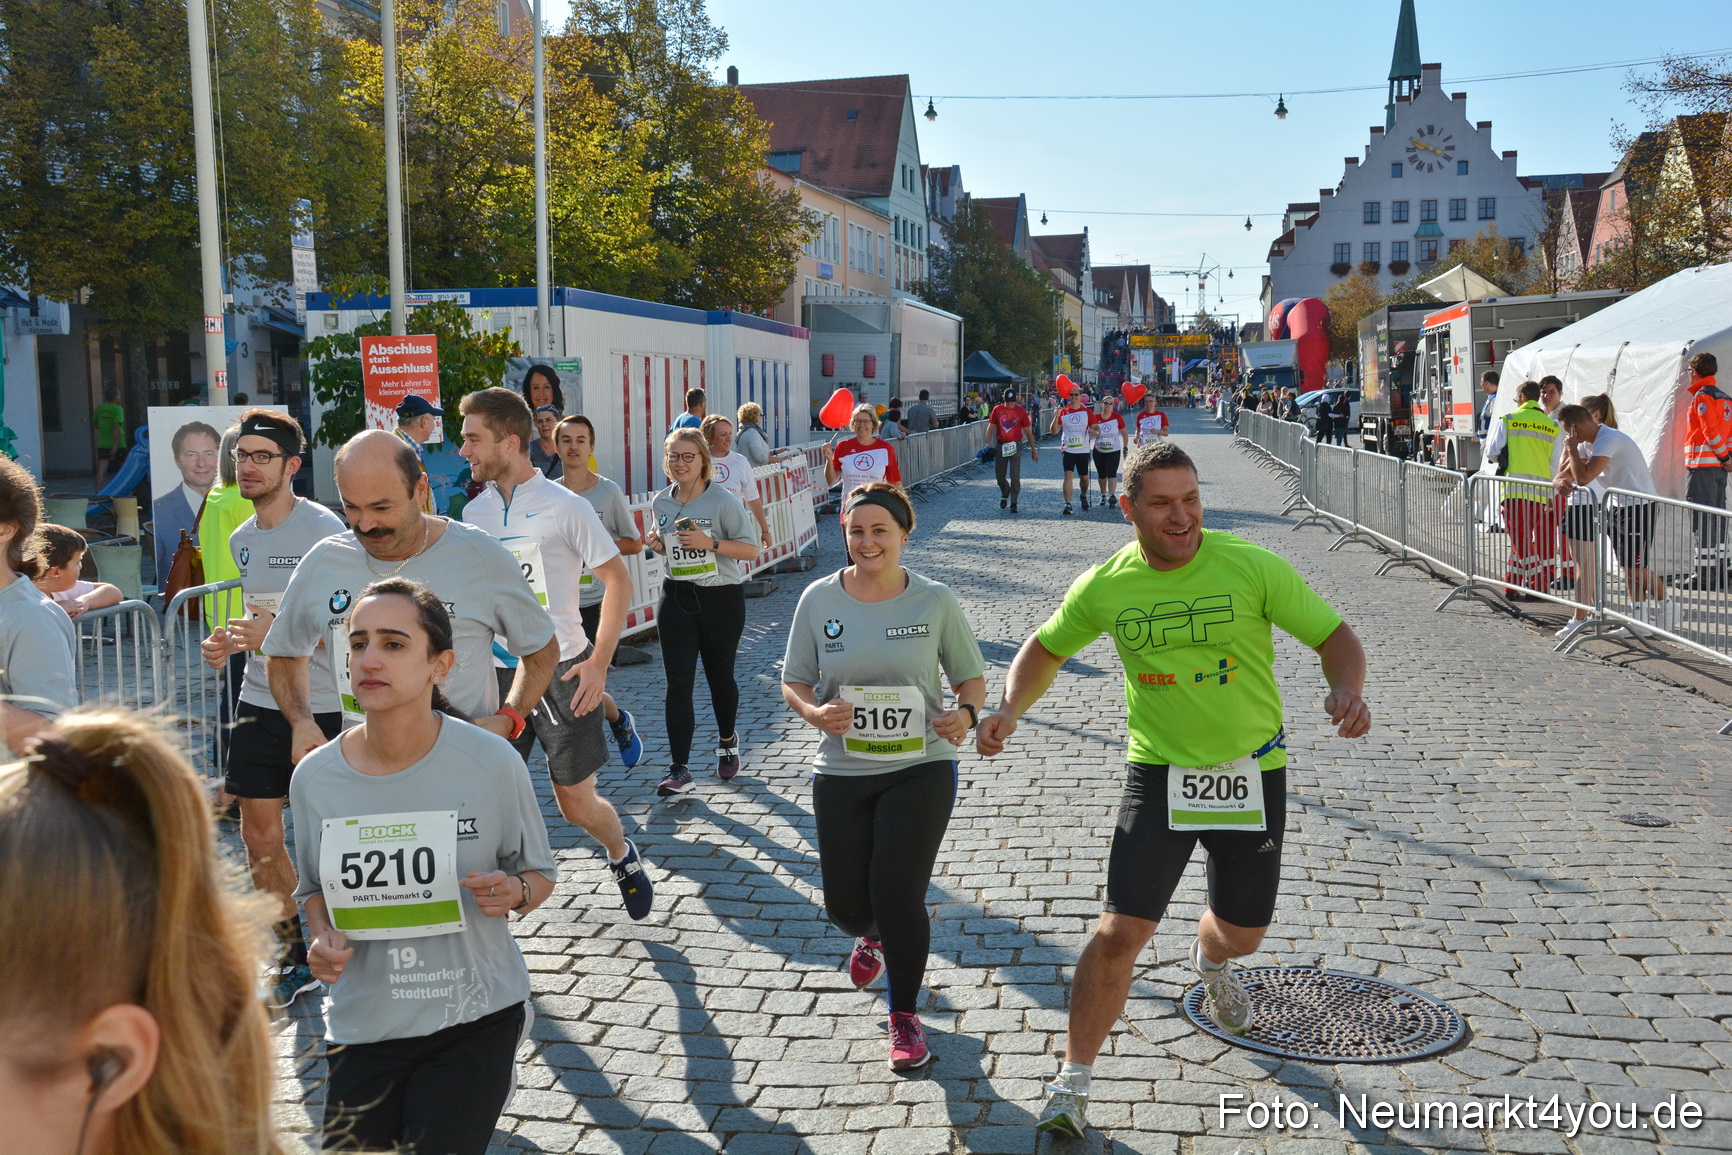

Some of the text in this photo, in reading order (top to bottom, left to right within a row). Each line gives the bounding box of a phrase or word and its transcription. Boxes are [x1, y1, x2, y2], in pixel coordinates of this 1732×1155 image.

[21, 319, 33, 327] Hut
[42, 318, 58, 327] Mode
[1156, 336, 1183, 345] START
[241, 342, 249, 359] 3
[368, 342, 433, 356] Abschluss
[368, 356, 390, 364] statt
[369, 363, 434, 375] Ausschluss!
[150, 380, 180, 390] STREB
[381, 380, 400, 388] Mehr
[400, 379, 423, 387] Lehrer
[378, 387, 433, 396] kleinere Klassen.
[1512, 421, 1555, 434] Org.-Leiter
[692, 517, 713, 525] OCK
[269, 556, 301, 566] BOCK
[885, 624, 930, 638] BOCK
[1137, 672, 1177, 685] MERZ
[864, 693, 901, 702] BOCK
[853, 707, 912, 731] 5167
[865, 743, 903, 753] Jessica
[1182, 774, 1249, 801] 5206
[358, 823, 417, 840] BOCK
[340, 846, 436, 890] 5210
[352, 892, 420, 902] PARTL Neumarkt
[387, 946, 425, 970] 19.
[389, 967, 467, 984] Neumarkter
[391, 985, 455, 999] Stadtlauf
